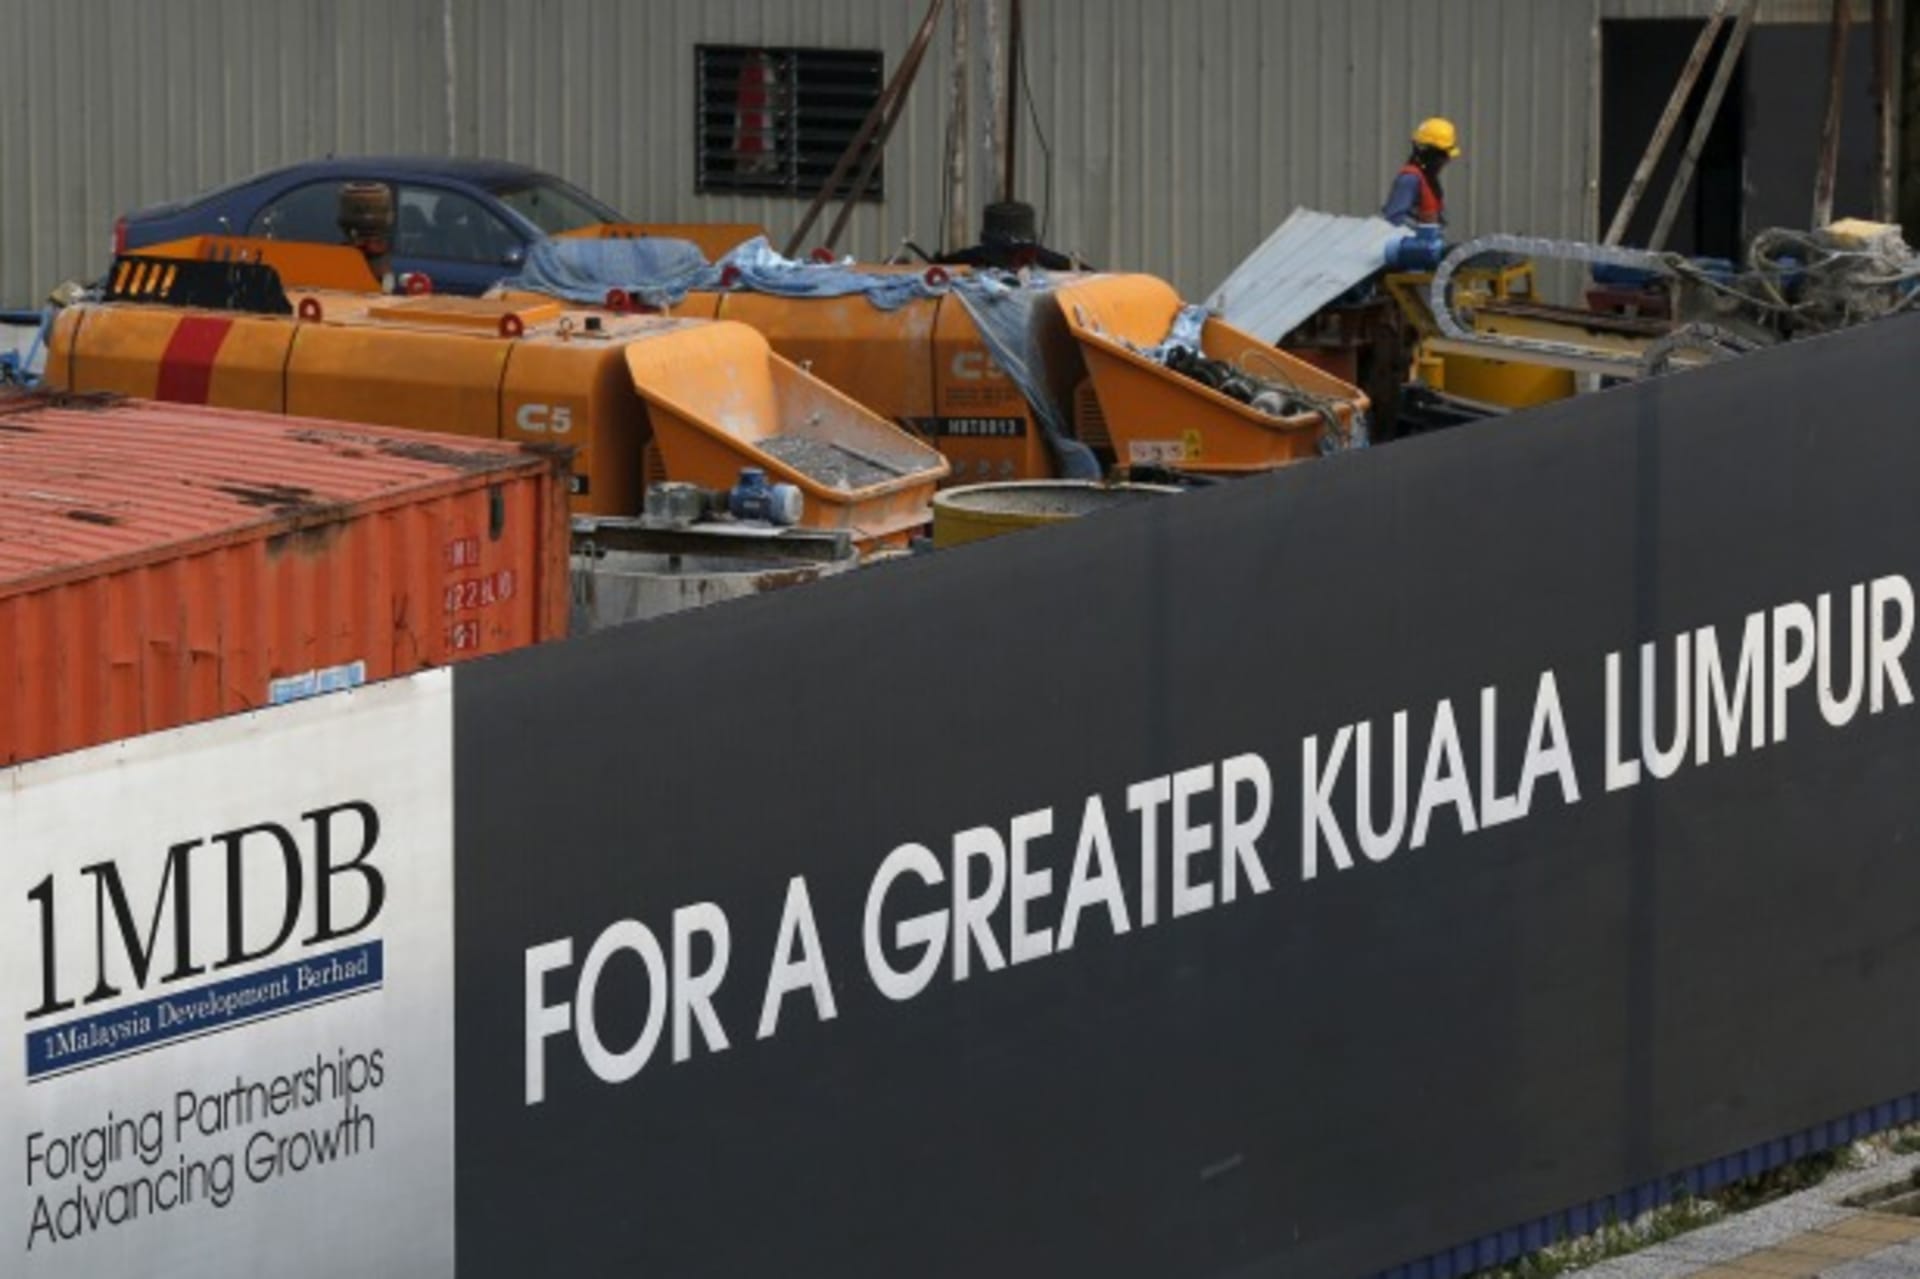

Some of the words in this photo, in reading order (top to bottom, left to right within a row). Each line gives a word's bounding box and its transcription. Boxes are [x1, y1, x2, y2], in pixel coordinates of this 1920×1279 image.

[516, 403, 572, 433] C5
[25, 800, 386, 1020] 1MDB
[525, 901, 731, 1106] FOR
[756, 874, 838, 1040] A
[863, 752, 1273, 1001] GREATER
[1302, 669, 1581, 880] KUALA
[1605, 574, 1916, 792] LUMPUR
[45, 1011, 151, 1060] 1Malaysia
[158, 978, 290, 1028] Development
[297, 952, 369, 991] Berhad
[26, 1110, 162, 1187] Forging
[176, 1048, 385, 1143] Partnerships
[26, 1154, 235, 1251] Advancing
[244, 1103, 376, 1184] Growth
